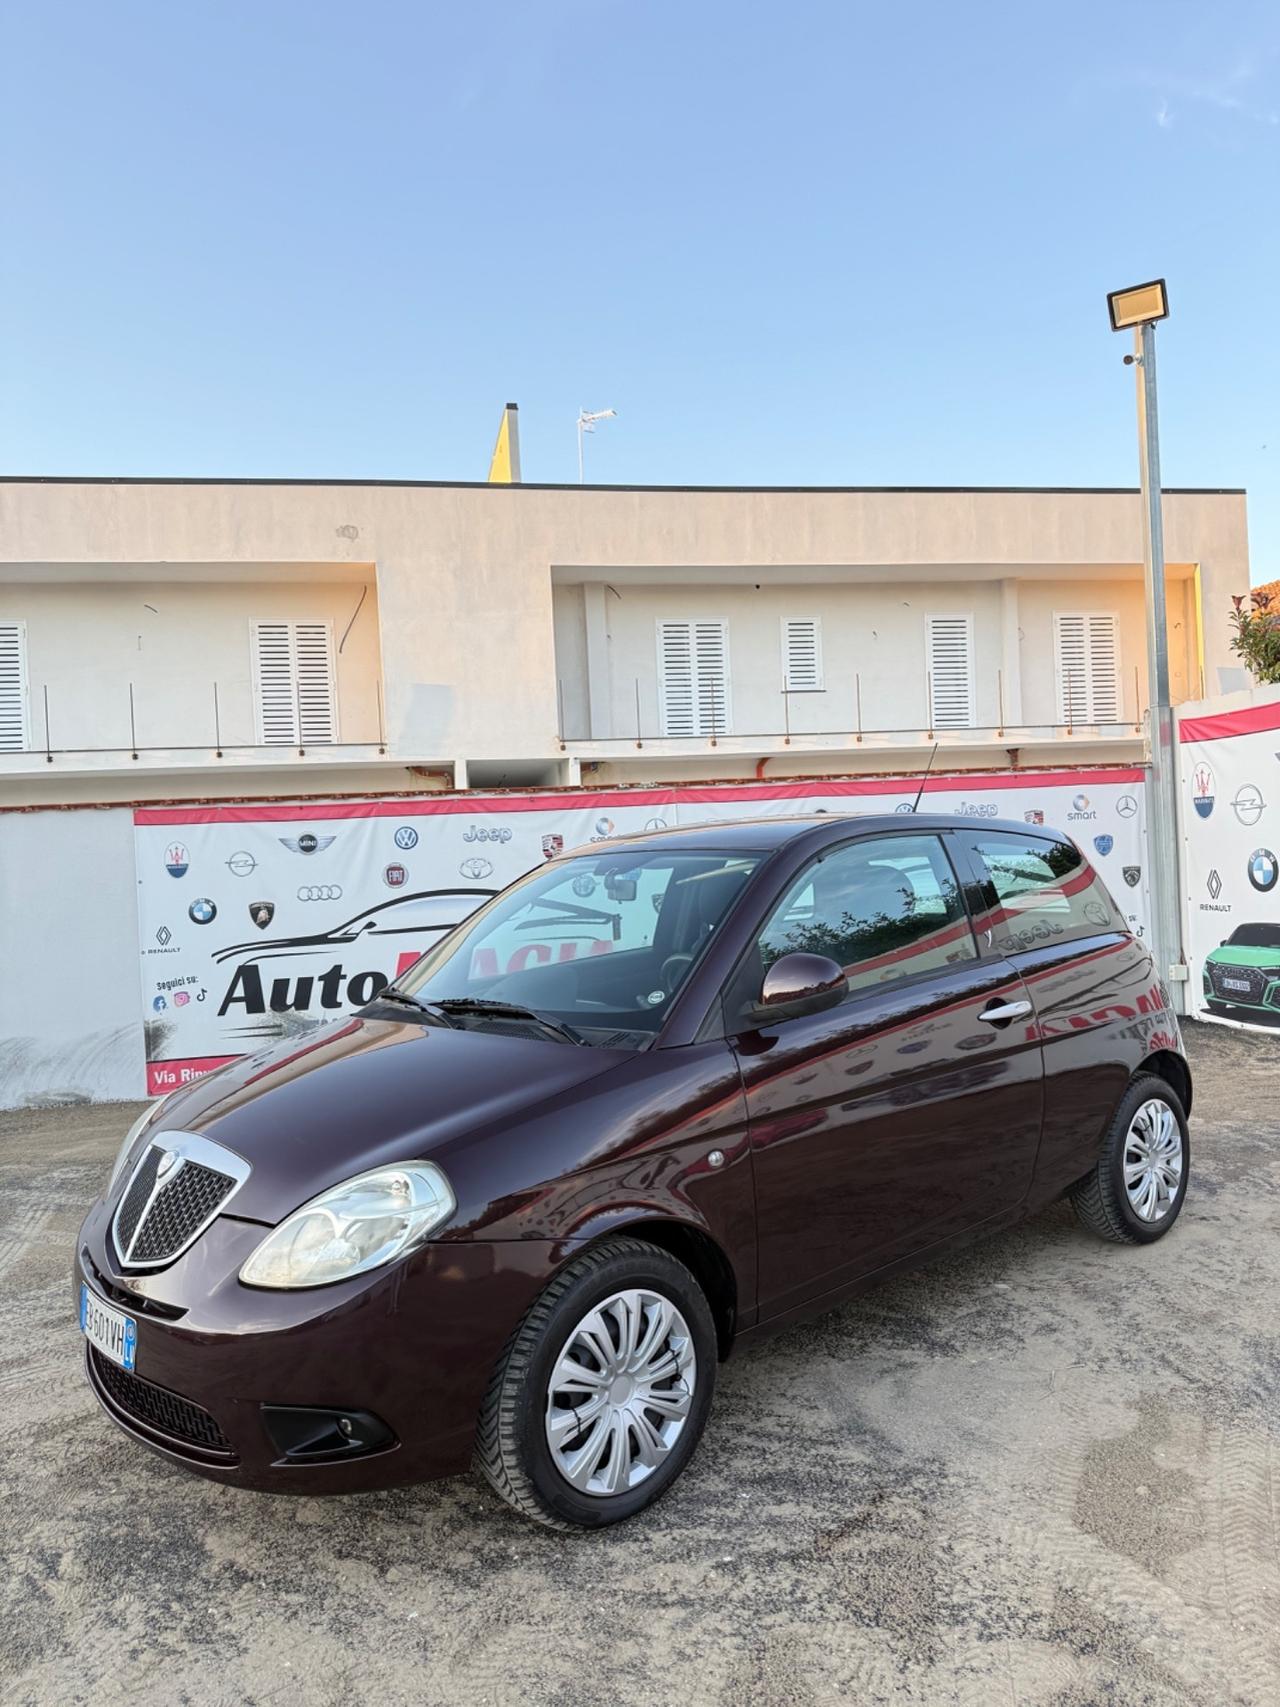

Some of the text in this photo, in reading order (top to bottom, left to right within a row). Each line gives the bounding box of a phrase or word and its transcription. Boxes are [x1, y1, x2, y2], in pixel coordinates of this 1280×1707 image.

[954, 801, 998, 817] Jeep
[1067, 809, 1096, 821] smart
[463, 825, 513, 844] Jeep
[388, 869, 403, 882] FIAT
[1199, 903, 1232, 912] RENAULT
[153, 1070, 176, 1084] Via
